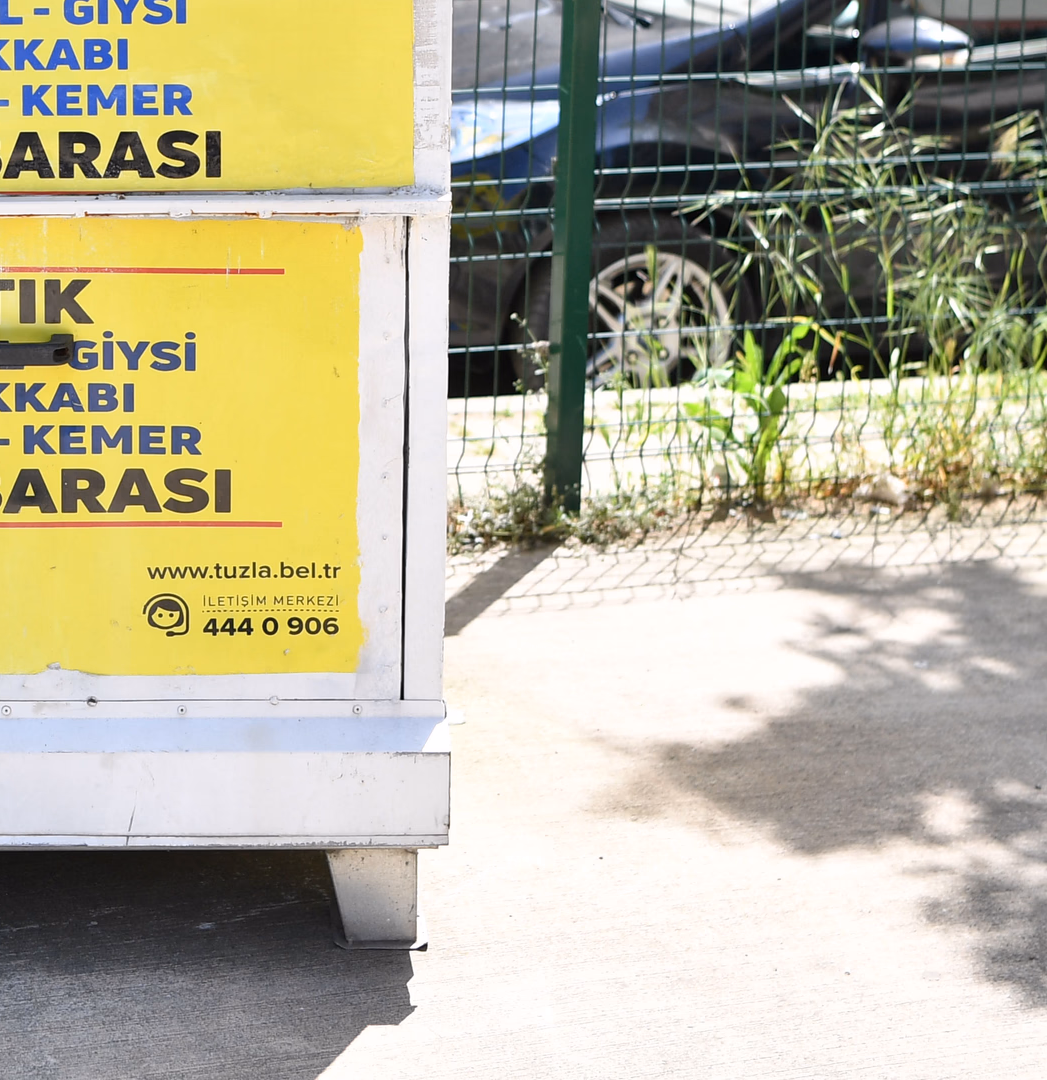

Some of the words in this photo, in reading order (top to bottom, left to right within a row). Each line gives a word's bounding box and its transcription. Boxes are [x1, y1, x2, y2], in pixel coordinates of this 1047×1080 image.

[22, 83, 193, 117] KEMER
[68, 330, 197, 371] GİYSİ
[23, 424, 202, 455] KEMER
[147, 562, 341, 580] www.tuzla.bel.tr
[203, 594, 267, 607] İLETİŞİM
[203, 617, 253, 636] 444
[262, 617, 279, 636] 0
[287, 617, 339, 636] 906
